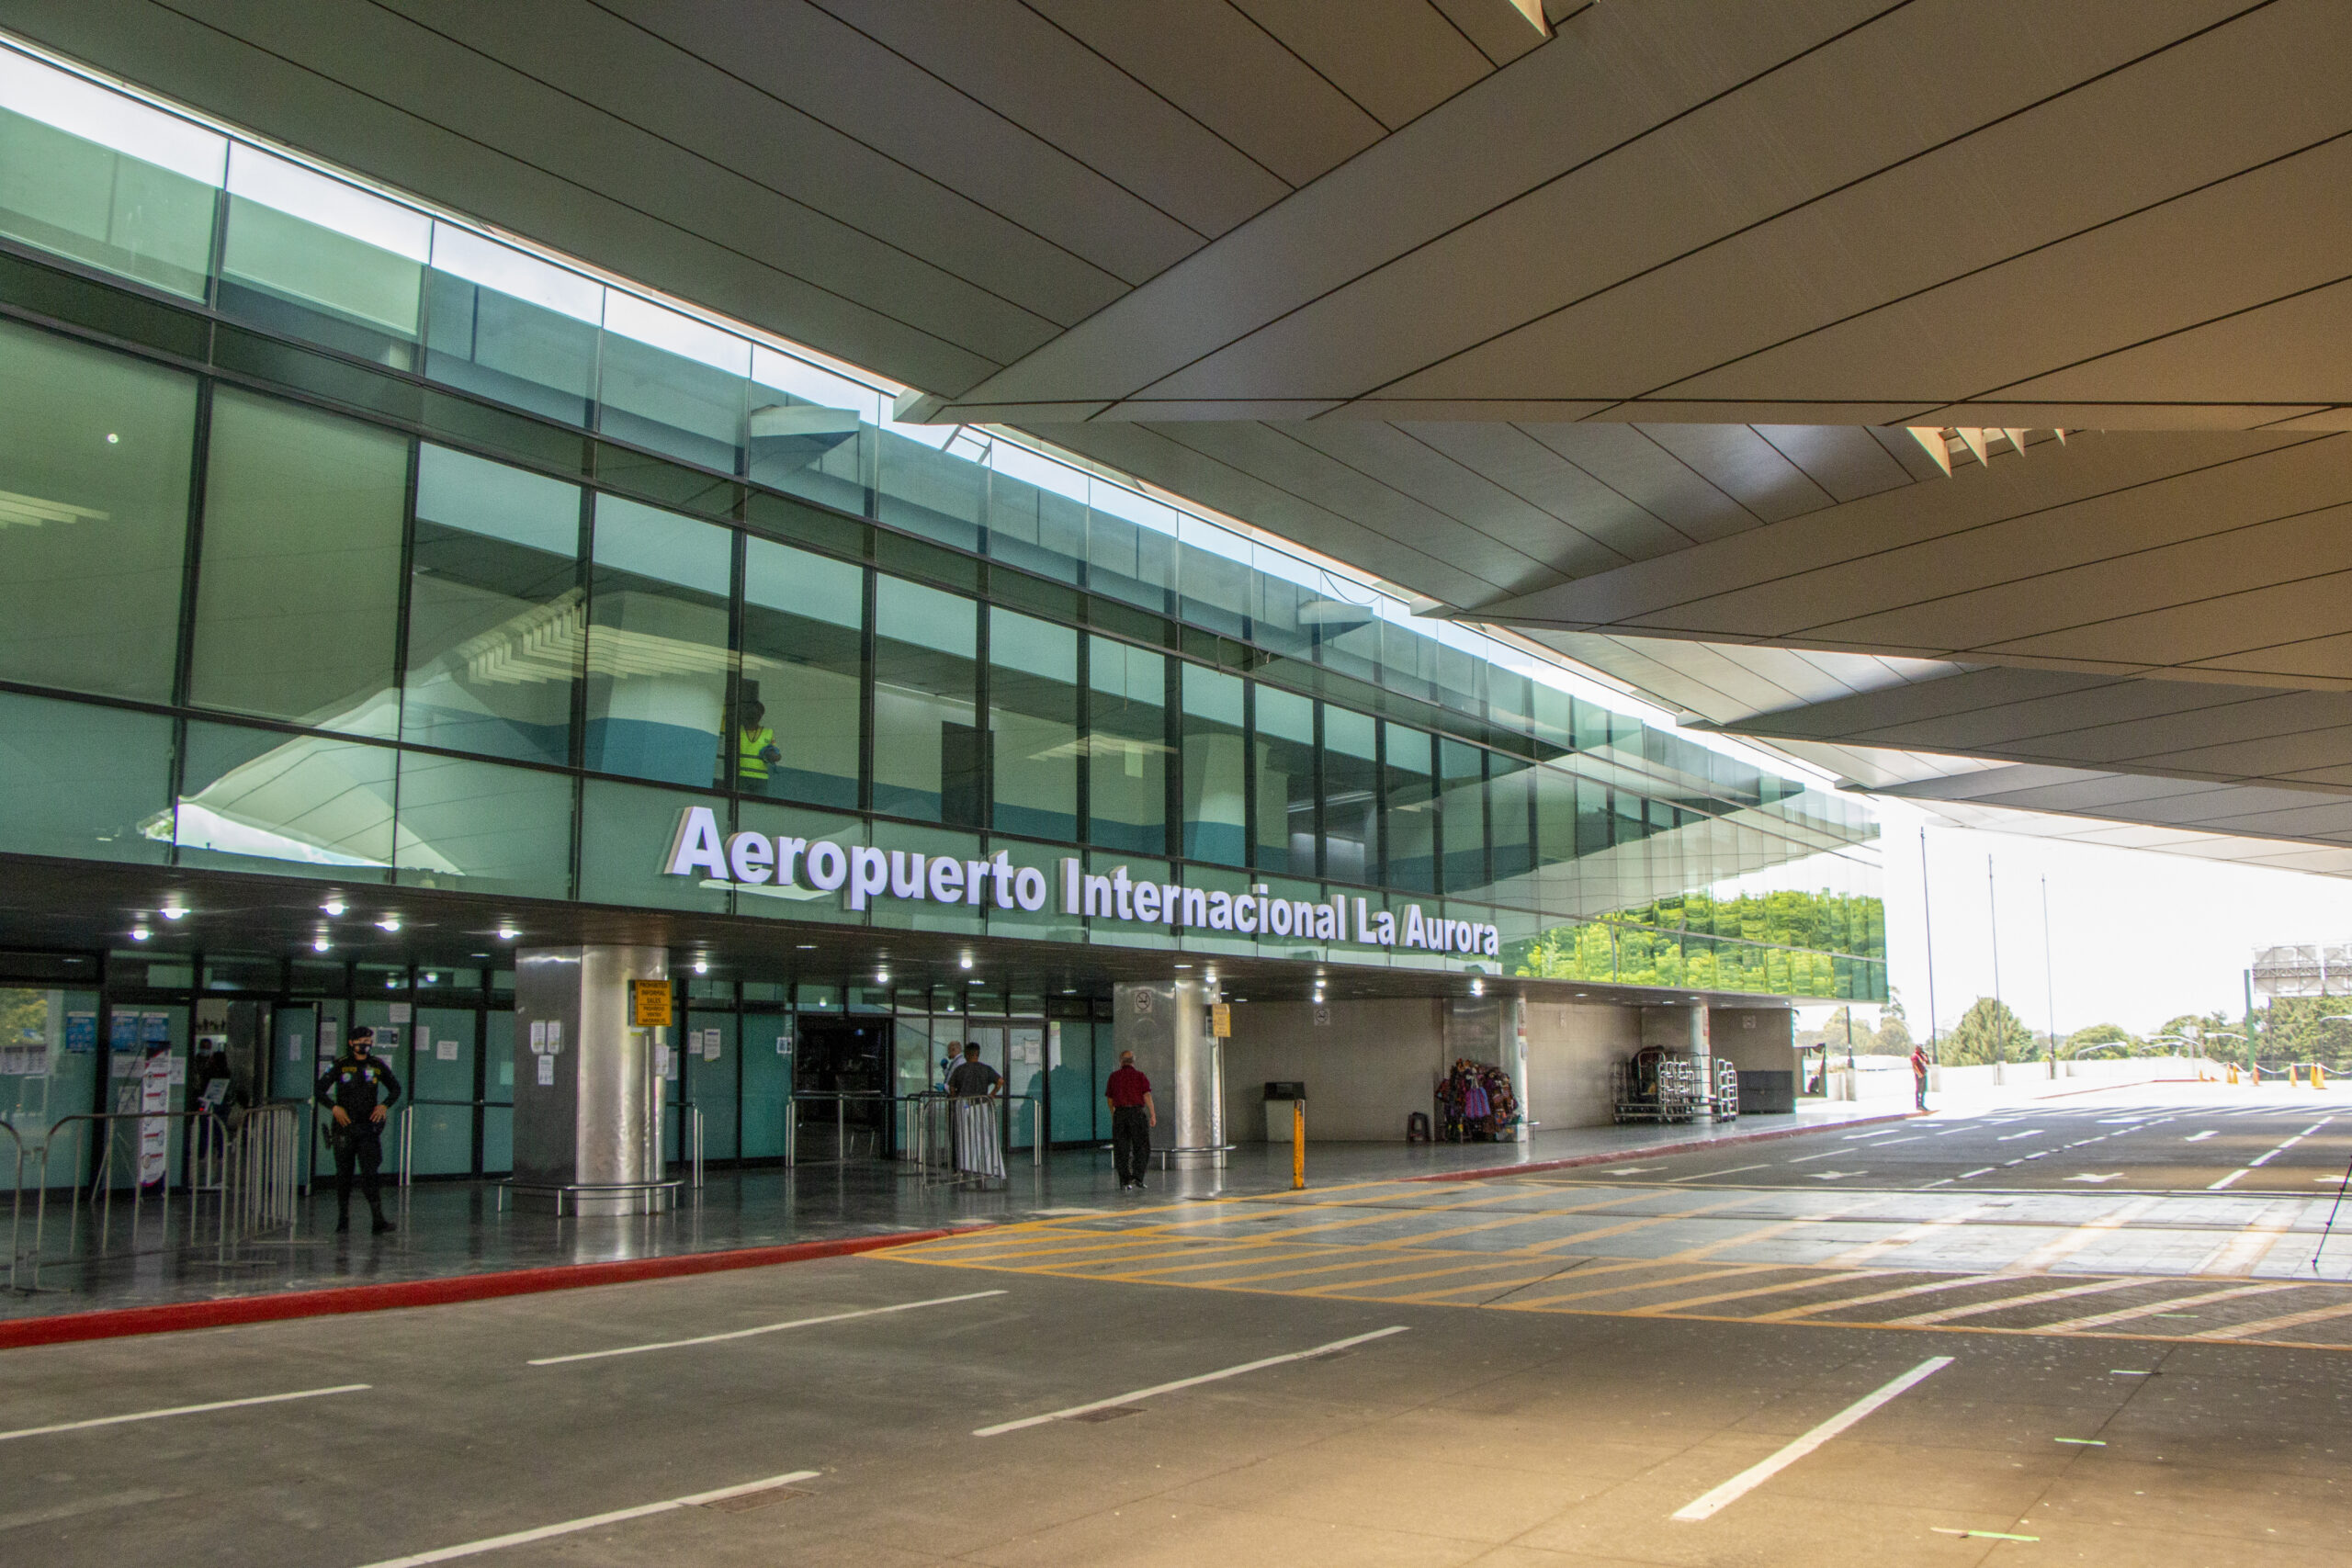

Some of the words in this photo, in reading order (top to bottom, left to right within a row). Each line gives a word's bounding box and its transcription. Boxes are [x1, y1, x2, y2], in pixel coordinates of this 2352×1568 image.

[666, 807, 1046, 911] Aeropuerto
[1062, 858, 1345, 941] Internacional
[1354, 897, 1396, 945] La
[1403, 904, 1499, 955] Aurora
